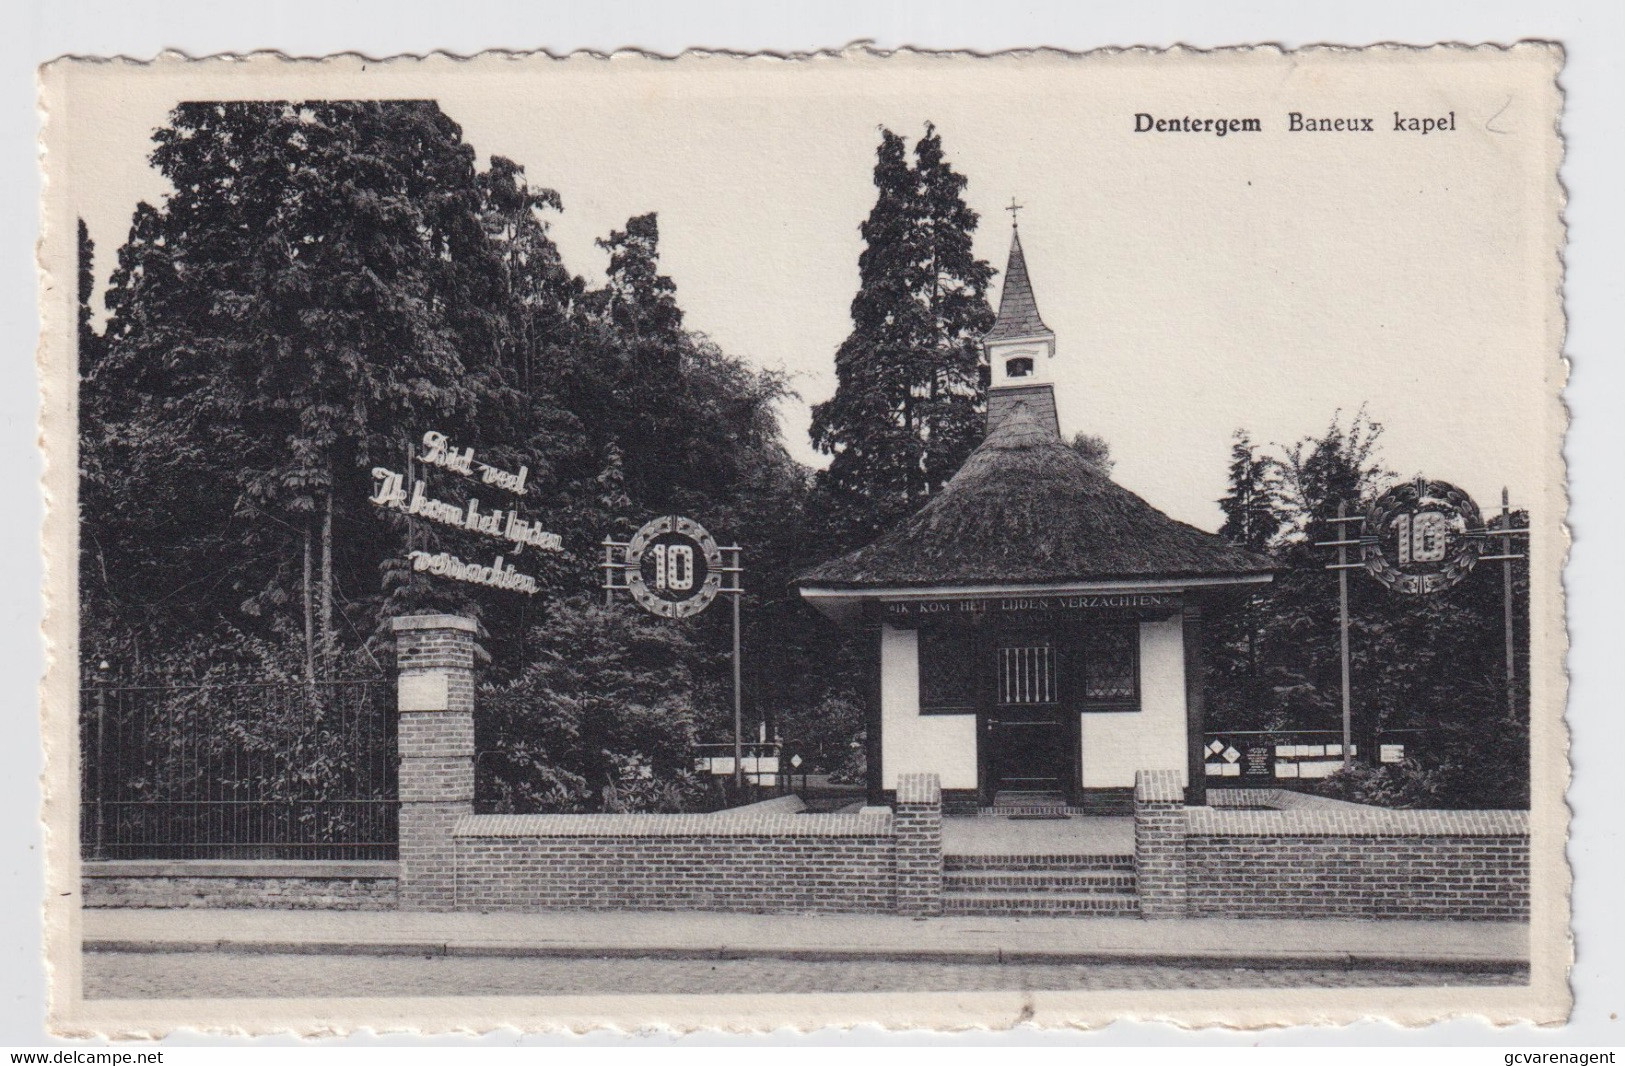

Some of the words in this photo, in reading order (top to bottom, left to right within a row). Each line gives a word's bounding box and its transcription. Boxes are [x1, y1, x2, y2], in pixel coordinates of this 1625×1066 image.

[416, 431, 474, 476] Bid
[369, 467, 409, 509] Ik
[409, 480, 467, 525] kom
[465, 498, 504, 535] het
[505, 510, 565, 555] lijden
[1390, 511, 1446, 564] 10
[649, 544, 693, 590] 10
[919, 602, 951, 613] KOM
[959, 600, 988, 612] HET
[1001, 597, 1048, 611] LIJDEN
